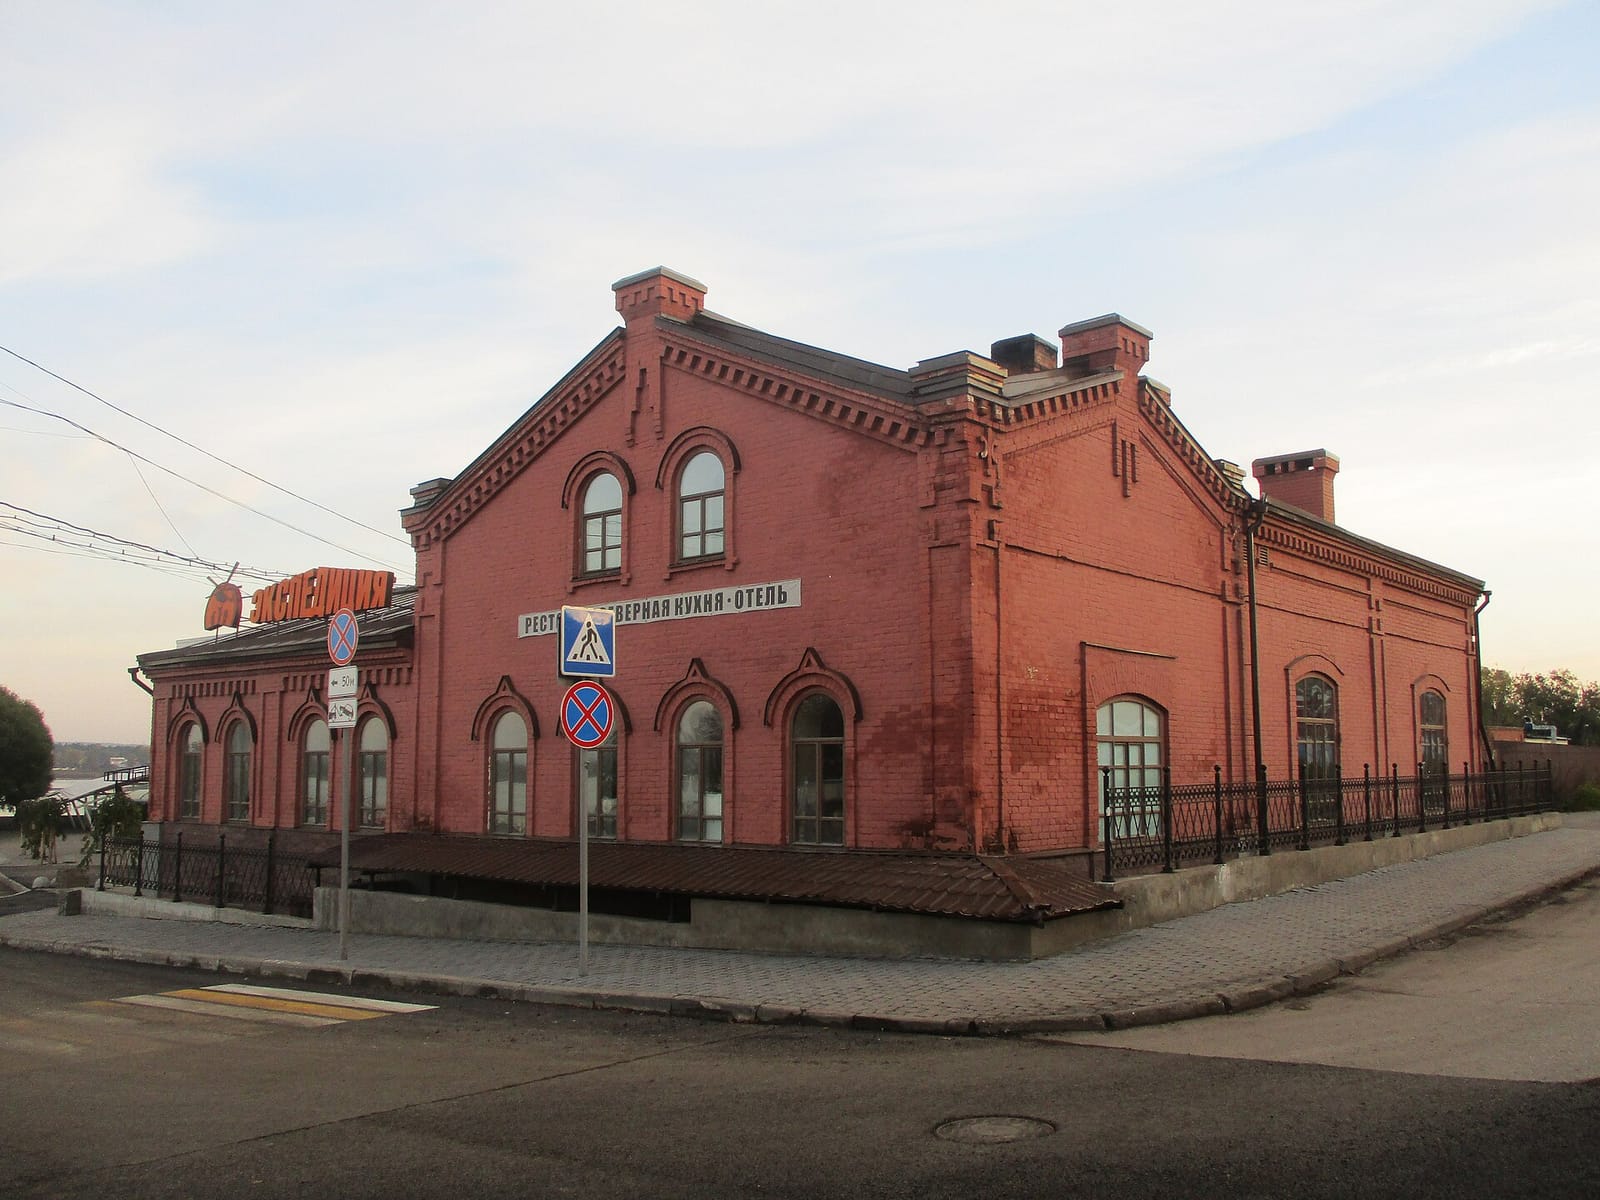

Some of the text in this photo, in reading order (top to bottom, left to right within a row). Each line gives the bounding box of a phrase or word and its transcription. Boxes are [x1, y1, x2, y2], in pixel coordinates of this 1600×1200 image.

[250, 567, 390, 622] ЭКСПЕДИЦИЯ
[525, 585, 788, 634] РЕСТ ВЕРНАЯ КУХНЯ ОТЕЛЬ
